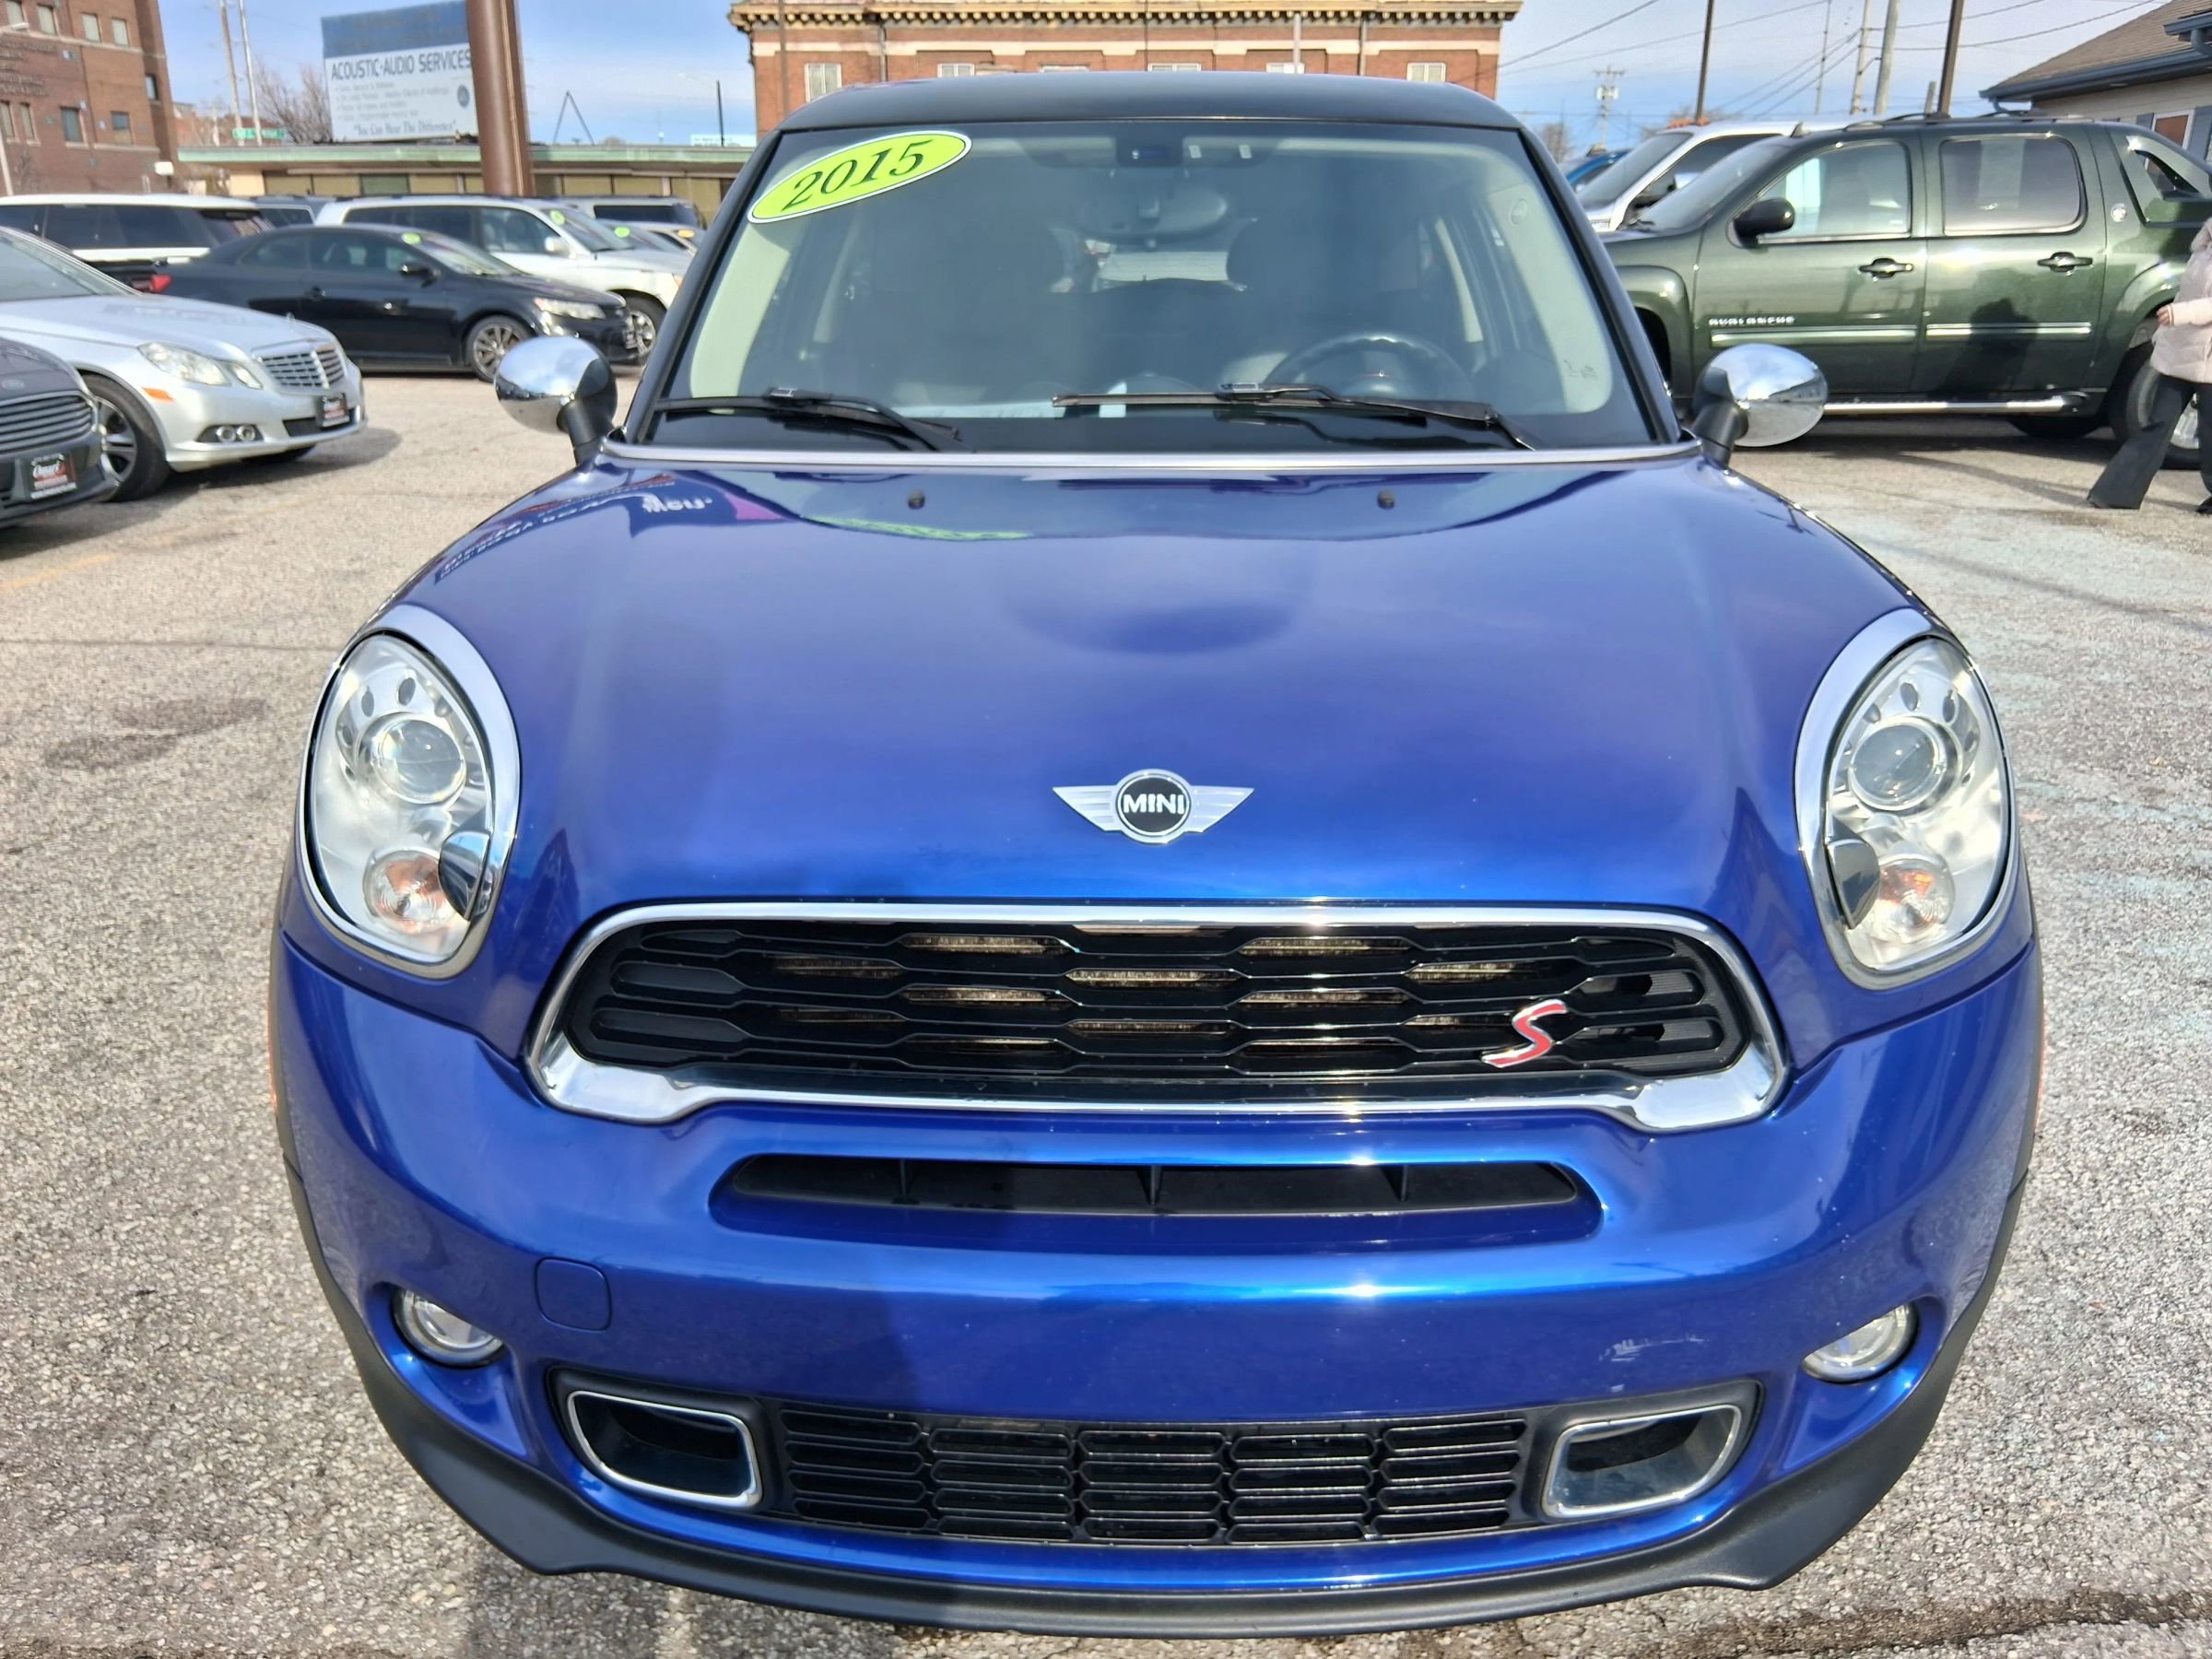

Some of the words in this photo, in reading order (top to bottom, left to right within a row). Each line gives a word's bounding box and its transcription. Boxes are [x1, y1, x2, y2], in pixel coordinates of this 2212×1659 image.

[418, 49, 470, 73] SERVICES
[781, 139, 933, 212] 2015
[1708, 315, 1794, 326] AVALANCHE
[1123, 794, 1185, 815] MINI
[1481, 998, 1568, 1069] S
